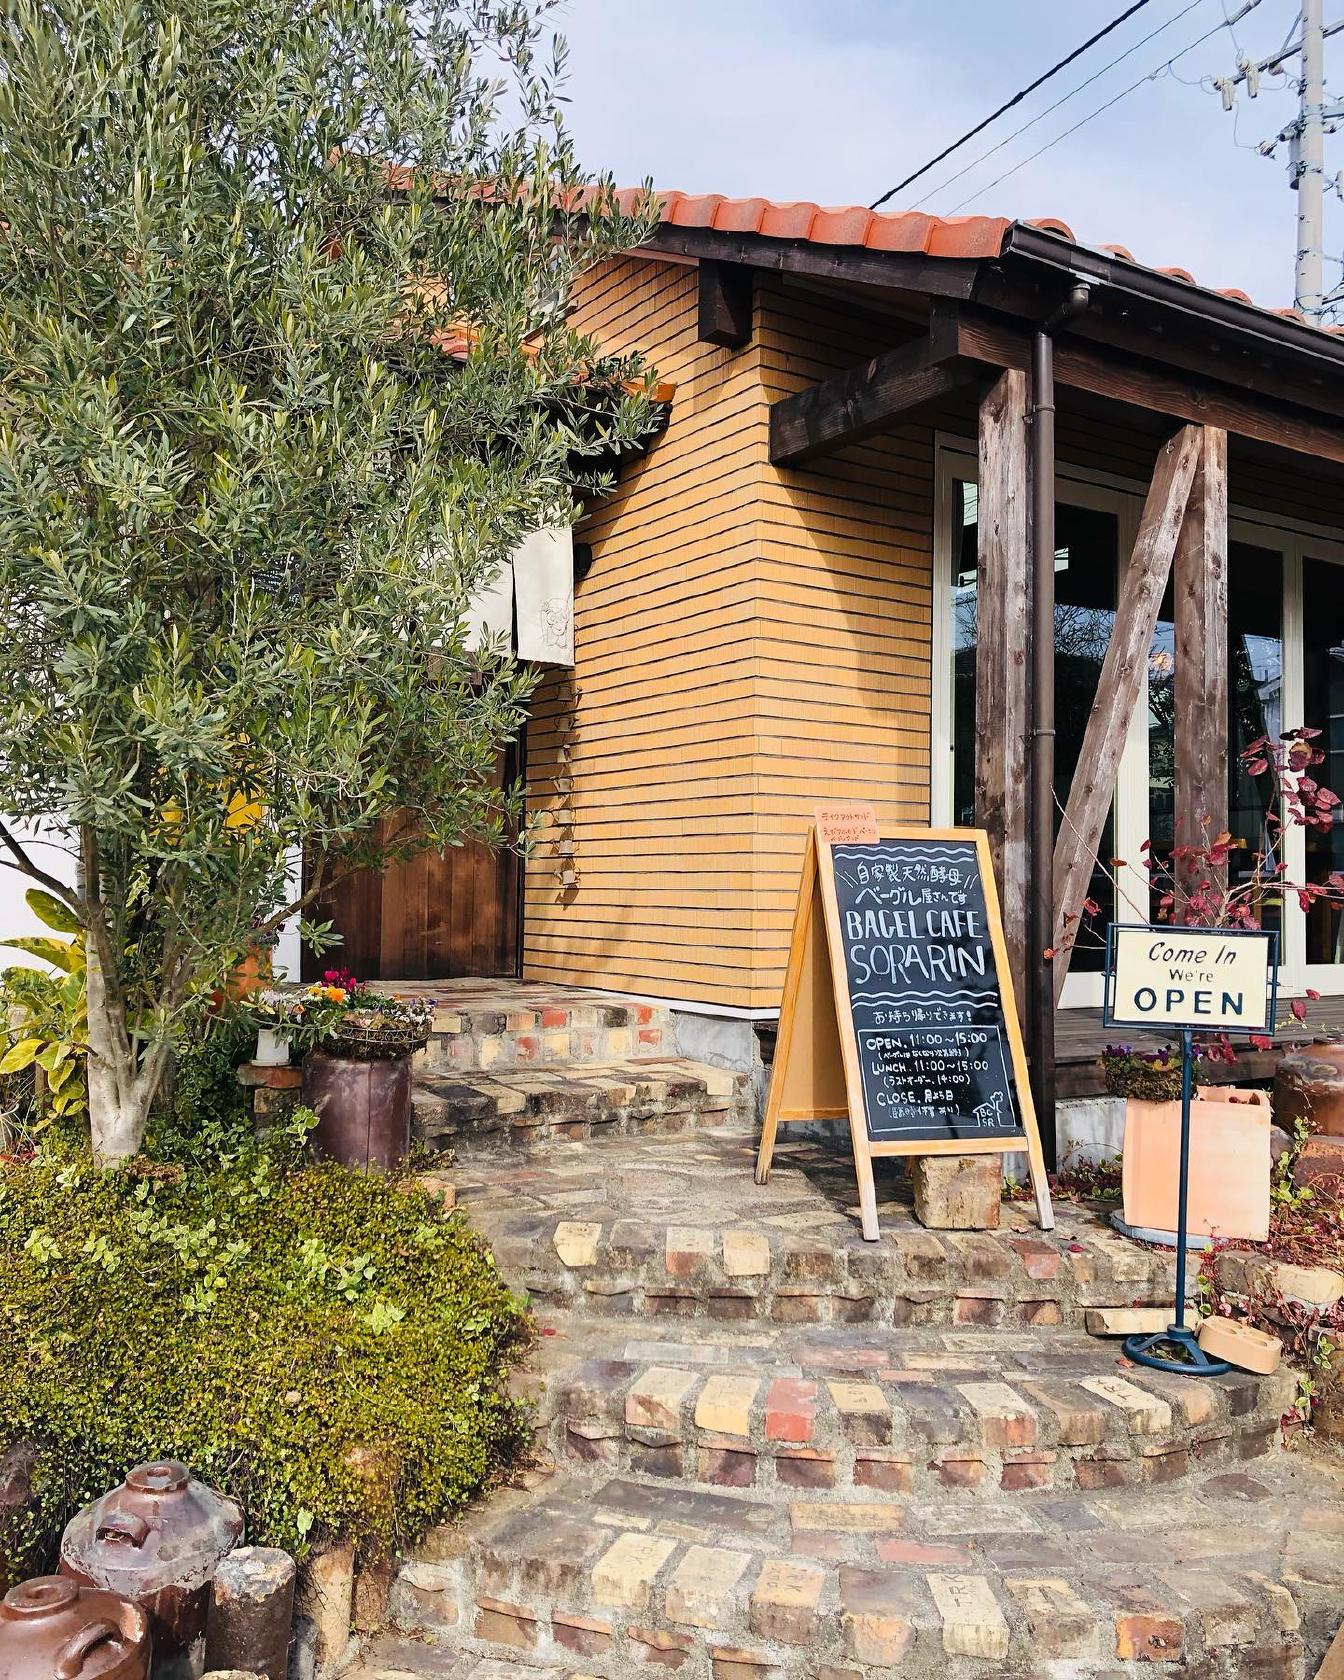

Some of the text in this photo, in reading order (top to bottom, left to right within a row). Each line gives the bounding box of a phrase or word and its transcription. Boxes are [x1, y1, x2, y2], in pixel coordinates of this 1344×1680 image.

[857, 861, 964, 886] 自家製天然酵母
[855, 886, 967, 905] ベーグル屋さんです
[846, 910, 983, 939] BAGEL CAFE
[850, 944, 986, 985] SORARIN
[1149, 941, 1237, 965] Come In
[1169, 968, 1214, 983] We're
[1134, 987, 1243, 1015] OPEN
